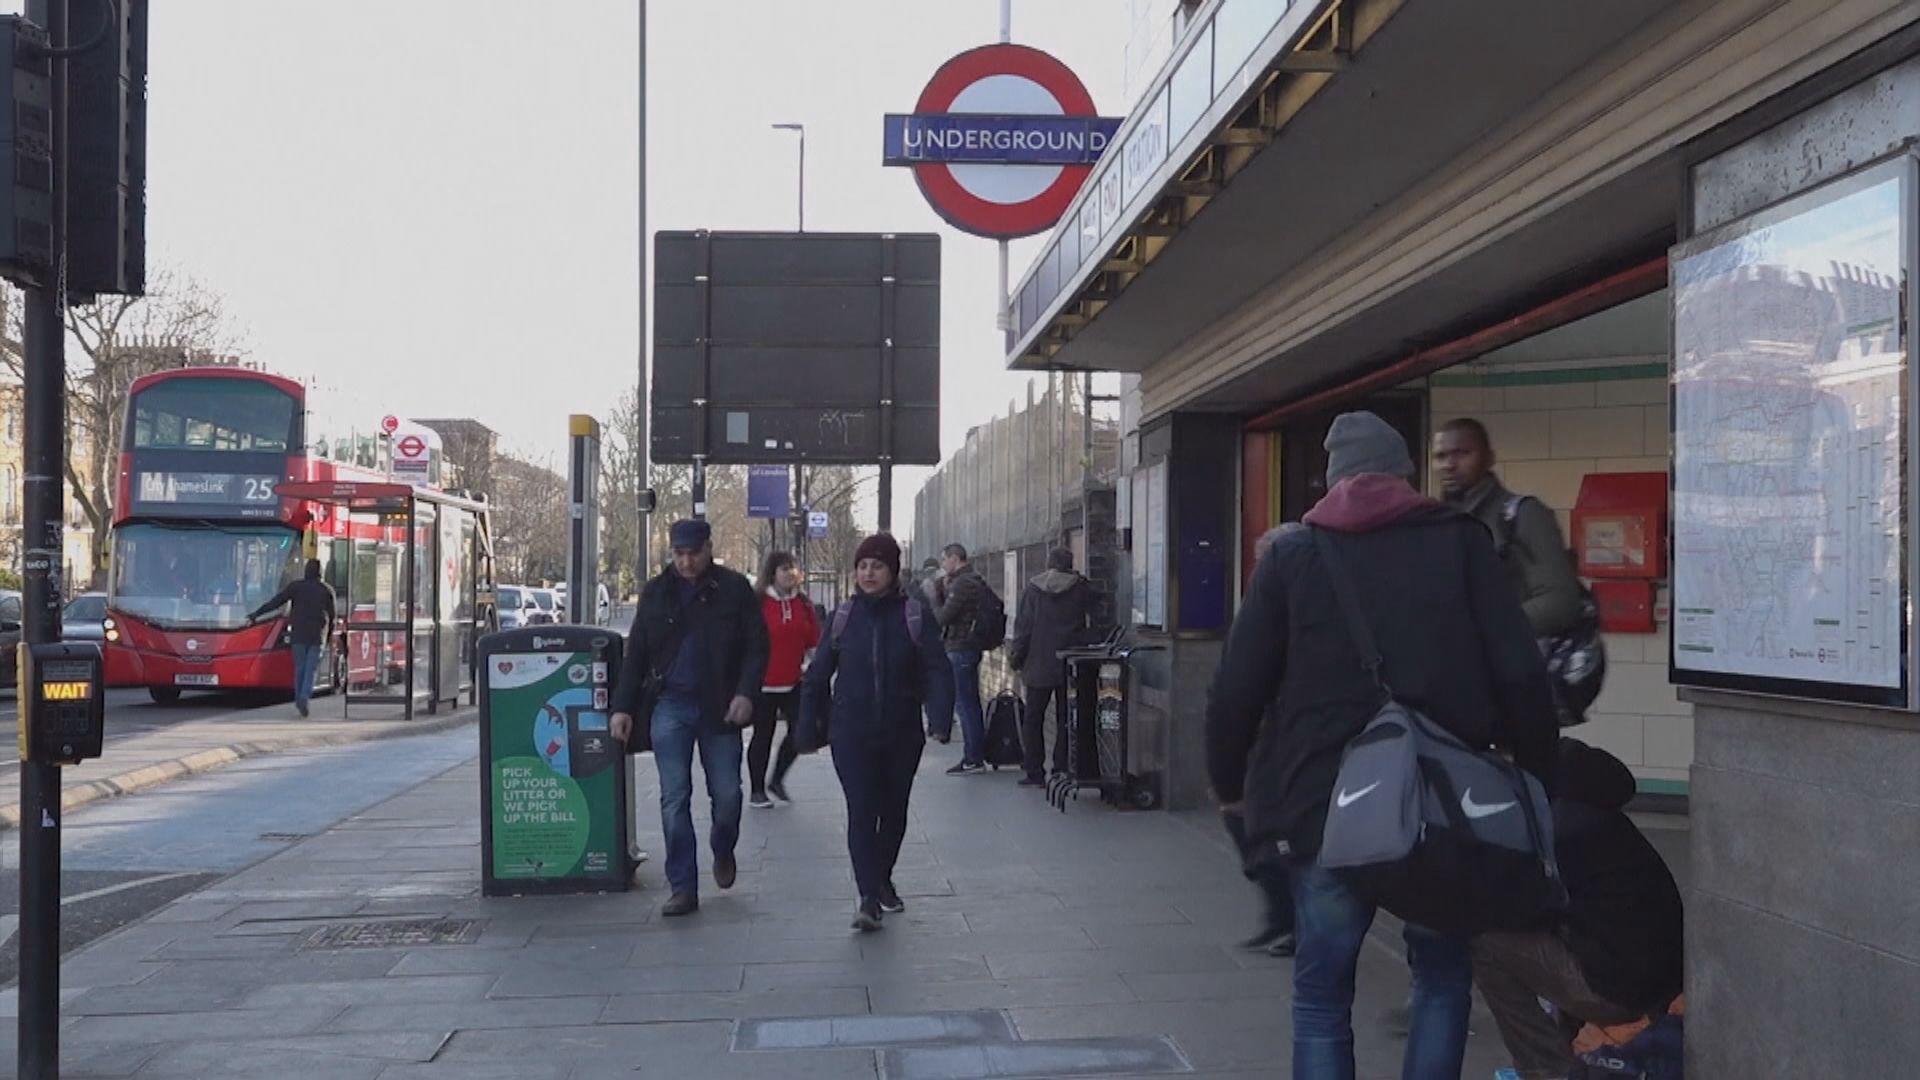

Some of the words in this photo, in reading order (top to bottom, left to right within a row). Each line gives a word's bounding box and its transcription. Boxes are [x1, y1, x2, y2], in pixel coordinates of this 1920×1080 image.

[903, 128, 1106, 152] UNDERGROUND
[244, 478, 273, 501] 25
[42, 682, 88, 699] WAIT
[502, 767, 532, 778] PICK
[503, 779, 520, 790] UP
[522, 777, 558, 789] YOUR
[503, 789, 545, 801] LITTER
[547, 788, 567, 800] OR
[503, 802, 525, 813] WE
[527, 801, 558, 812] PICK
[503, 814, 521, 824] UP
[523, 812, 548, 823] THE
[550, 811, 577, 822] BILL
